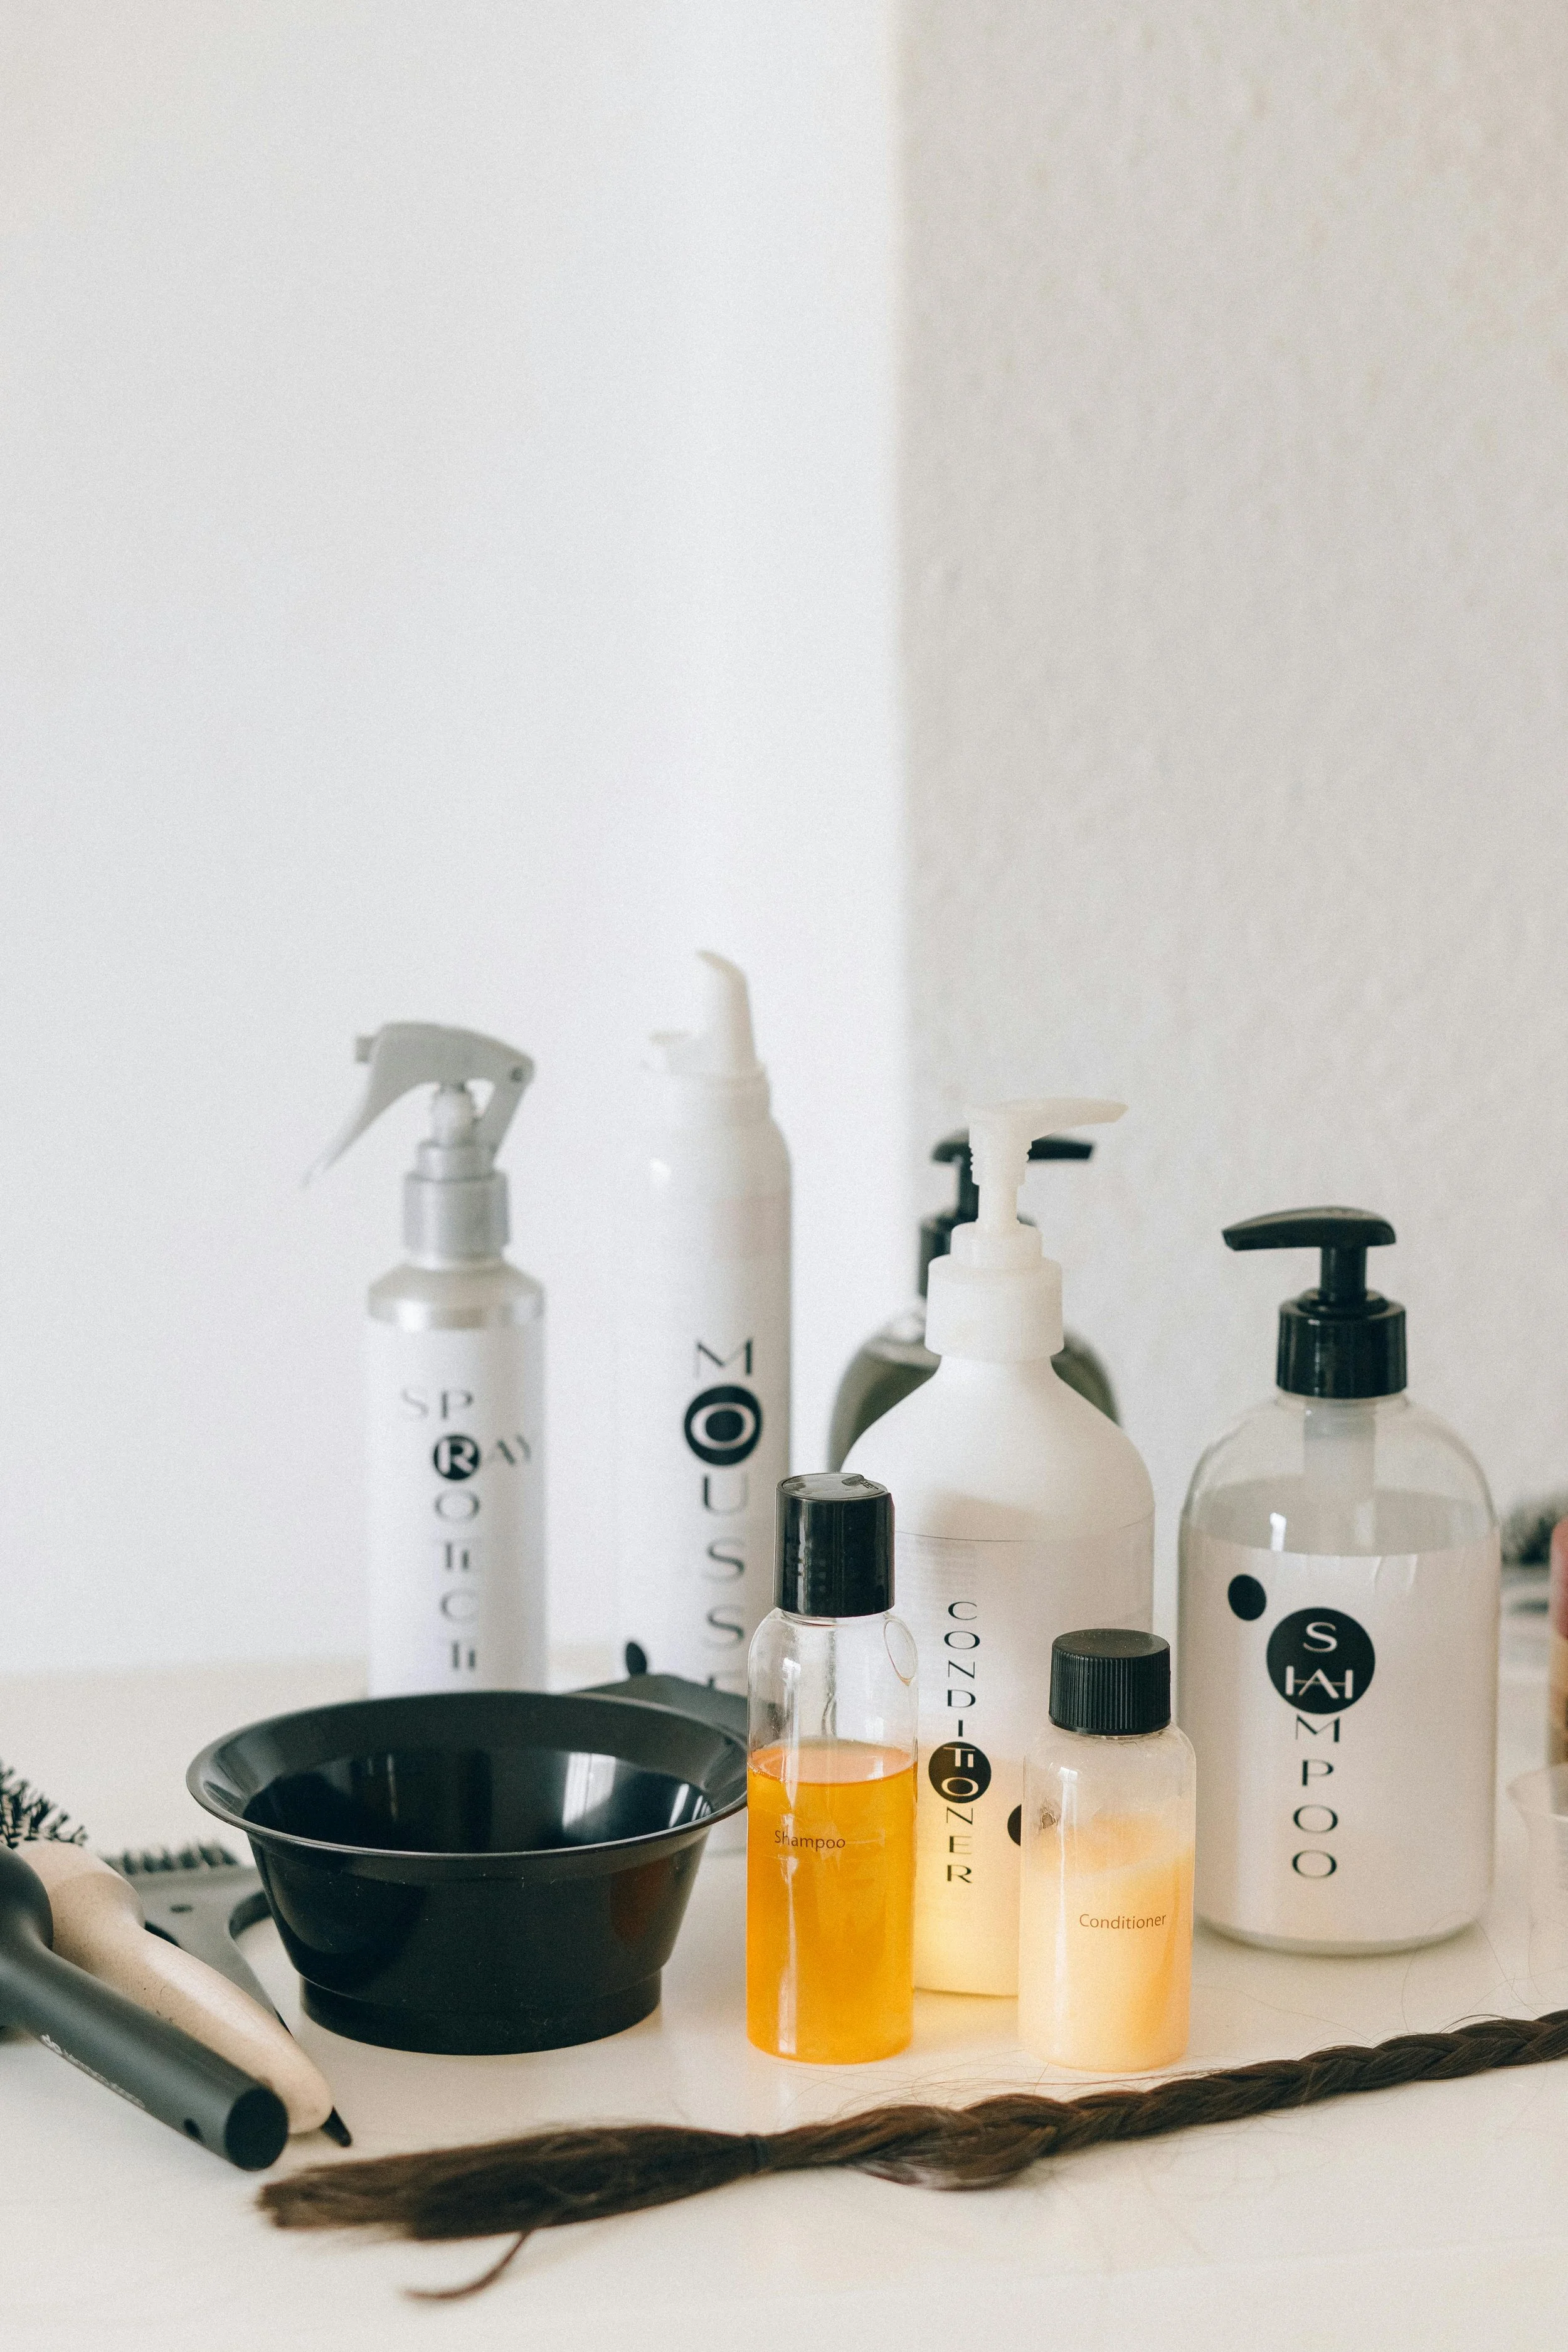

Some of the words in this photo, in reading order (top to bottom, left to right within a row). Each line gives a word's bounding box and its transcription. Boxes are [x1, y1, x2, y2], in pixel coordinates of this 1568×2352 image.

[689, 1336, 756, 1691] MOUSS
[774, 1830, 845, 1852] Shampoo
[941, 1601, 980, 1883] CONDITIONER
[1285, 1621, 1353, 1879] SHAMPOO
[1079, 1914, 1167, 1929] Conditioner
